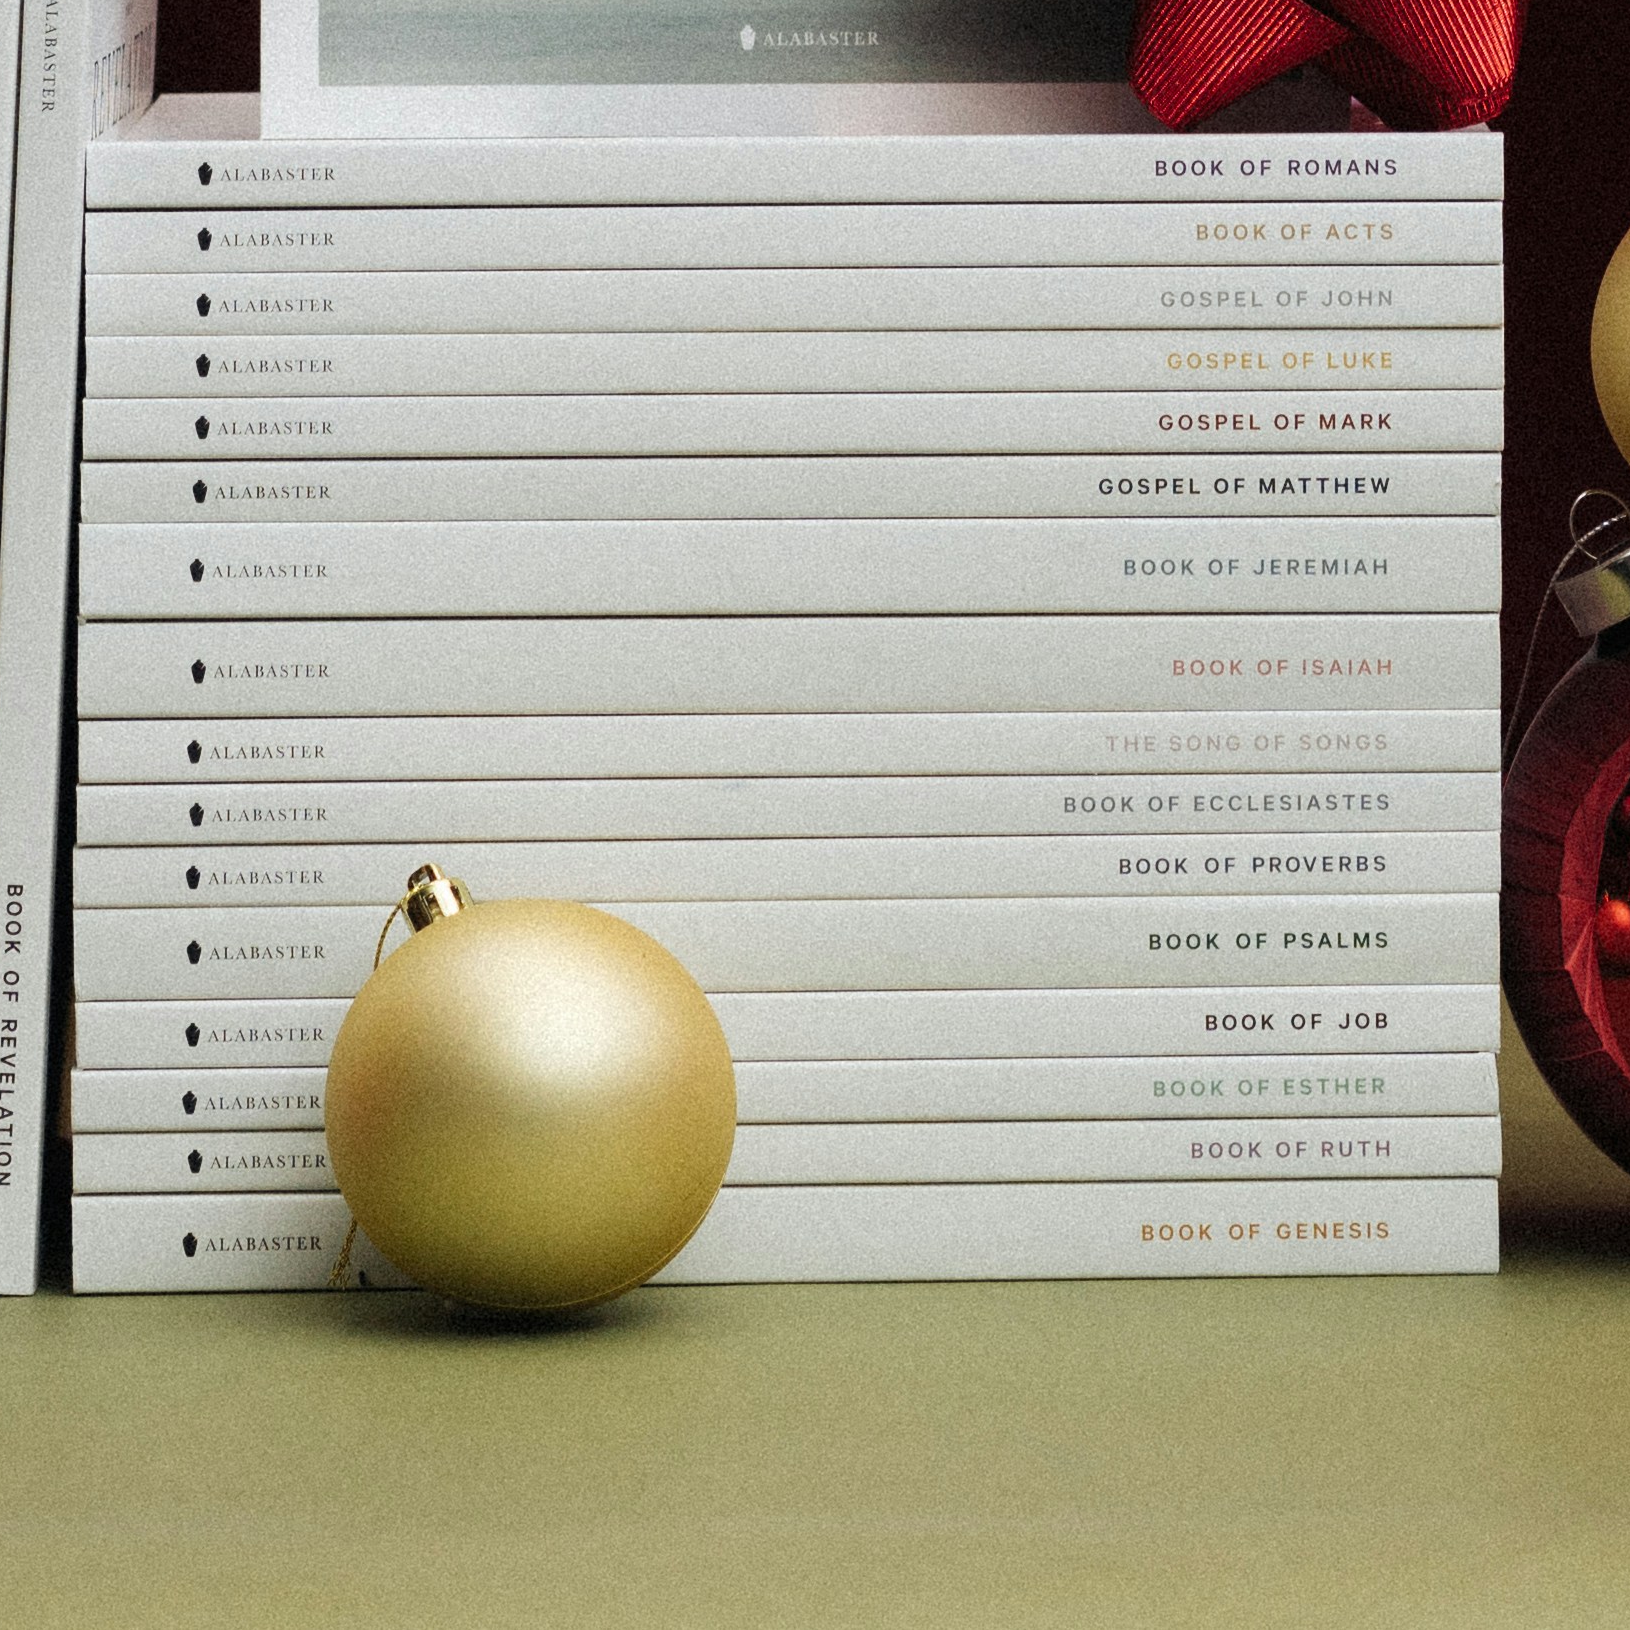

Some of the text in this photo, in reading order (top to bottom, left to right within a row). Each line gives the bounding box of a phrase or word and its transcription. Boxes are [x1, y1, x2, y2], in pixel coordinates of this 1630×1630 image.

[764, 30, 880, 47] ALABASTER
[220, 167, 335, 182] ALABASTER
[1154, 158, 1397, 177] BOOK OF ROMANS
[219, 232, 335, 248] ALABASTER
[1196, 222, 1394, 241] BOOK OF ACTS
[218, 298, 334, 313] ALABASTER
[1160, 289, 1392, 308] GOSPEL OF JOHN
[218, 359, 333, 374] ALABASTER
[1166, 351, 1393, 371] GOSPEL OF LUKE
[217, 420, 332, 436] ALABASTER
[1158, 413, 1392, 432] GOSPEL OF MARK
[214, 485, 331, 500] ALABASTER
[1098, 477, 1390, 496] GOSPEL OF MATTHEW
[212, 564, 328, 579] ALABASTER
[1123, 558, 1388, 577] BOOK OF JEREMIAH
[213, 663, 330, 679] ALABASTER
[1172, 658, 1392, 677] BOOK OF ISAIAH
[209, 744, 325, 760] ALABASTER
[1106, 734, 1387, 753] THE SONG OF SONGS
[1063, 793, 1390, 814] BOOK OF ECCLESIASTES
[211, 806, 328, 822] ALABASTER
[1118, 855, 1387, 875] BOOK OF PROVERBS
[208, 870, 324, 886] ALABASTER
[4, 883, 24, 954] BOOK
[1148, 931, 1389, 951] BOOK OF PSALMS
[208, 944, 326, 961] ALABASTER
[2, 969, 20, 1003] OF
[1204, 1012, 1389, 1032] BOOK OF JOB
[208, 1027, 326, 1043] ALABASTER
[1153, 1077, 1385, 1098] BOOK OF ESTHER
[204, 1094, 321, 1111] ALABASTER
[1190, 1140, 1391, 1160] BOOK OF RUTH
[209, 1153, 326, 1170] ALABASTER
[1140, 1221, 1390, 1242] BOOK OF GENESIS
[204, 1236, 322, 1252] ALABASTER
